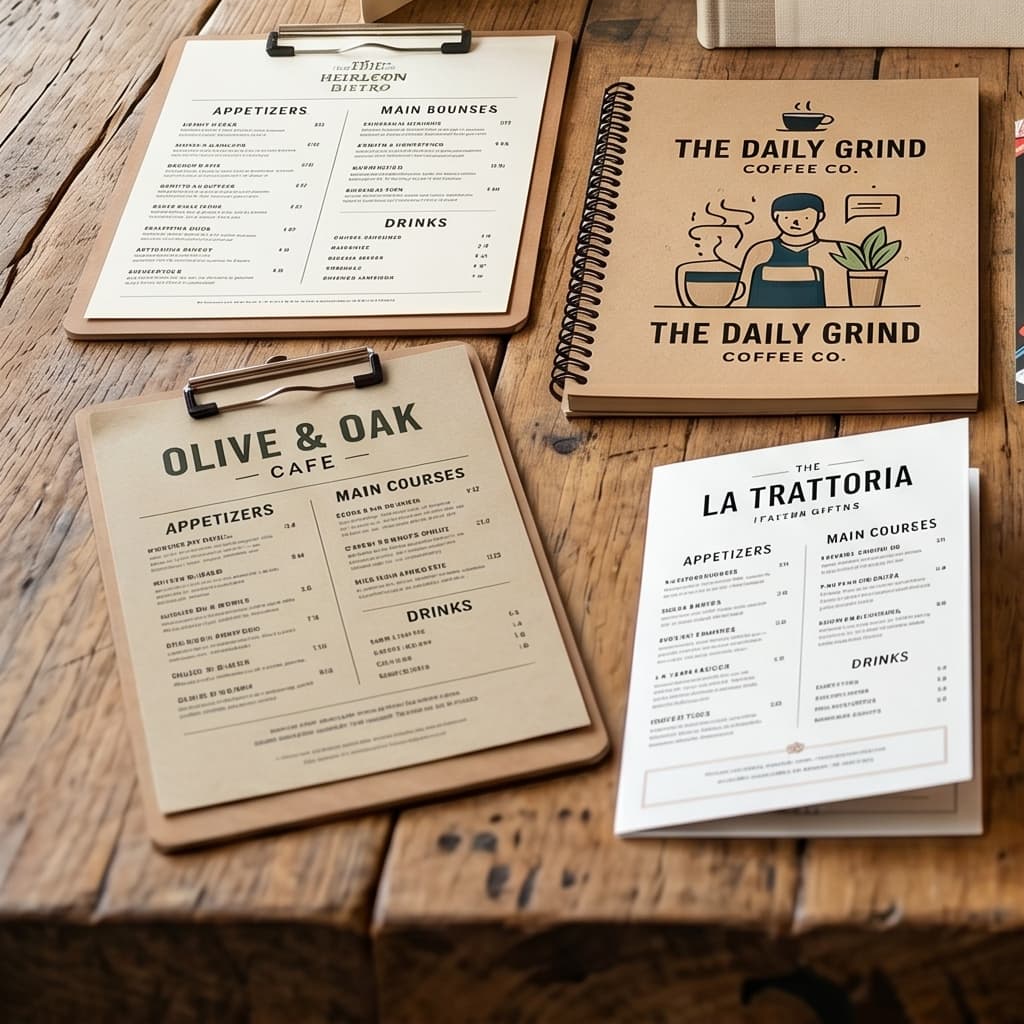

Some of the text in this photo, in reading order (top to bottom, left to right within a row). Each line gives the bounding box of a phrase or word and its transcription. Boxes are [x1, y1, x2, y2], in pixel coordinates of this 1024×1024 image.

[212, 105, 308, 116] APPETIZERS
[380, 105, 421, 115] MAIN
[674, 139, 927, 158] THE DAILY GRIND
[743, 164, 858, 174] COFFEE CO.
[384, 217, 448, 228] DRINKS
[650, 321, 921, 344] THE DAILY GRIND
[722, 352, 846, 362] COFFEE CO.
[162, 402, 423, 477] OLIVE & OAK
[270, 455, 335, 478] CAFE
[795, 462, 821, 473] THE
[335, 467, 465, 503] MAIN COURSES
[702, 465, 913, 517] LA TRATTORIA
[165, 503, 274, 535] APPETIZERS
[826, 518, 938, 545] MAIN COURSES
[682, 544, 773, 567] APPETIZERS
[406, 599, 473, 623] DRINKS
[851, 650, 909, 670] DRINKS
